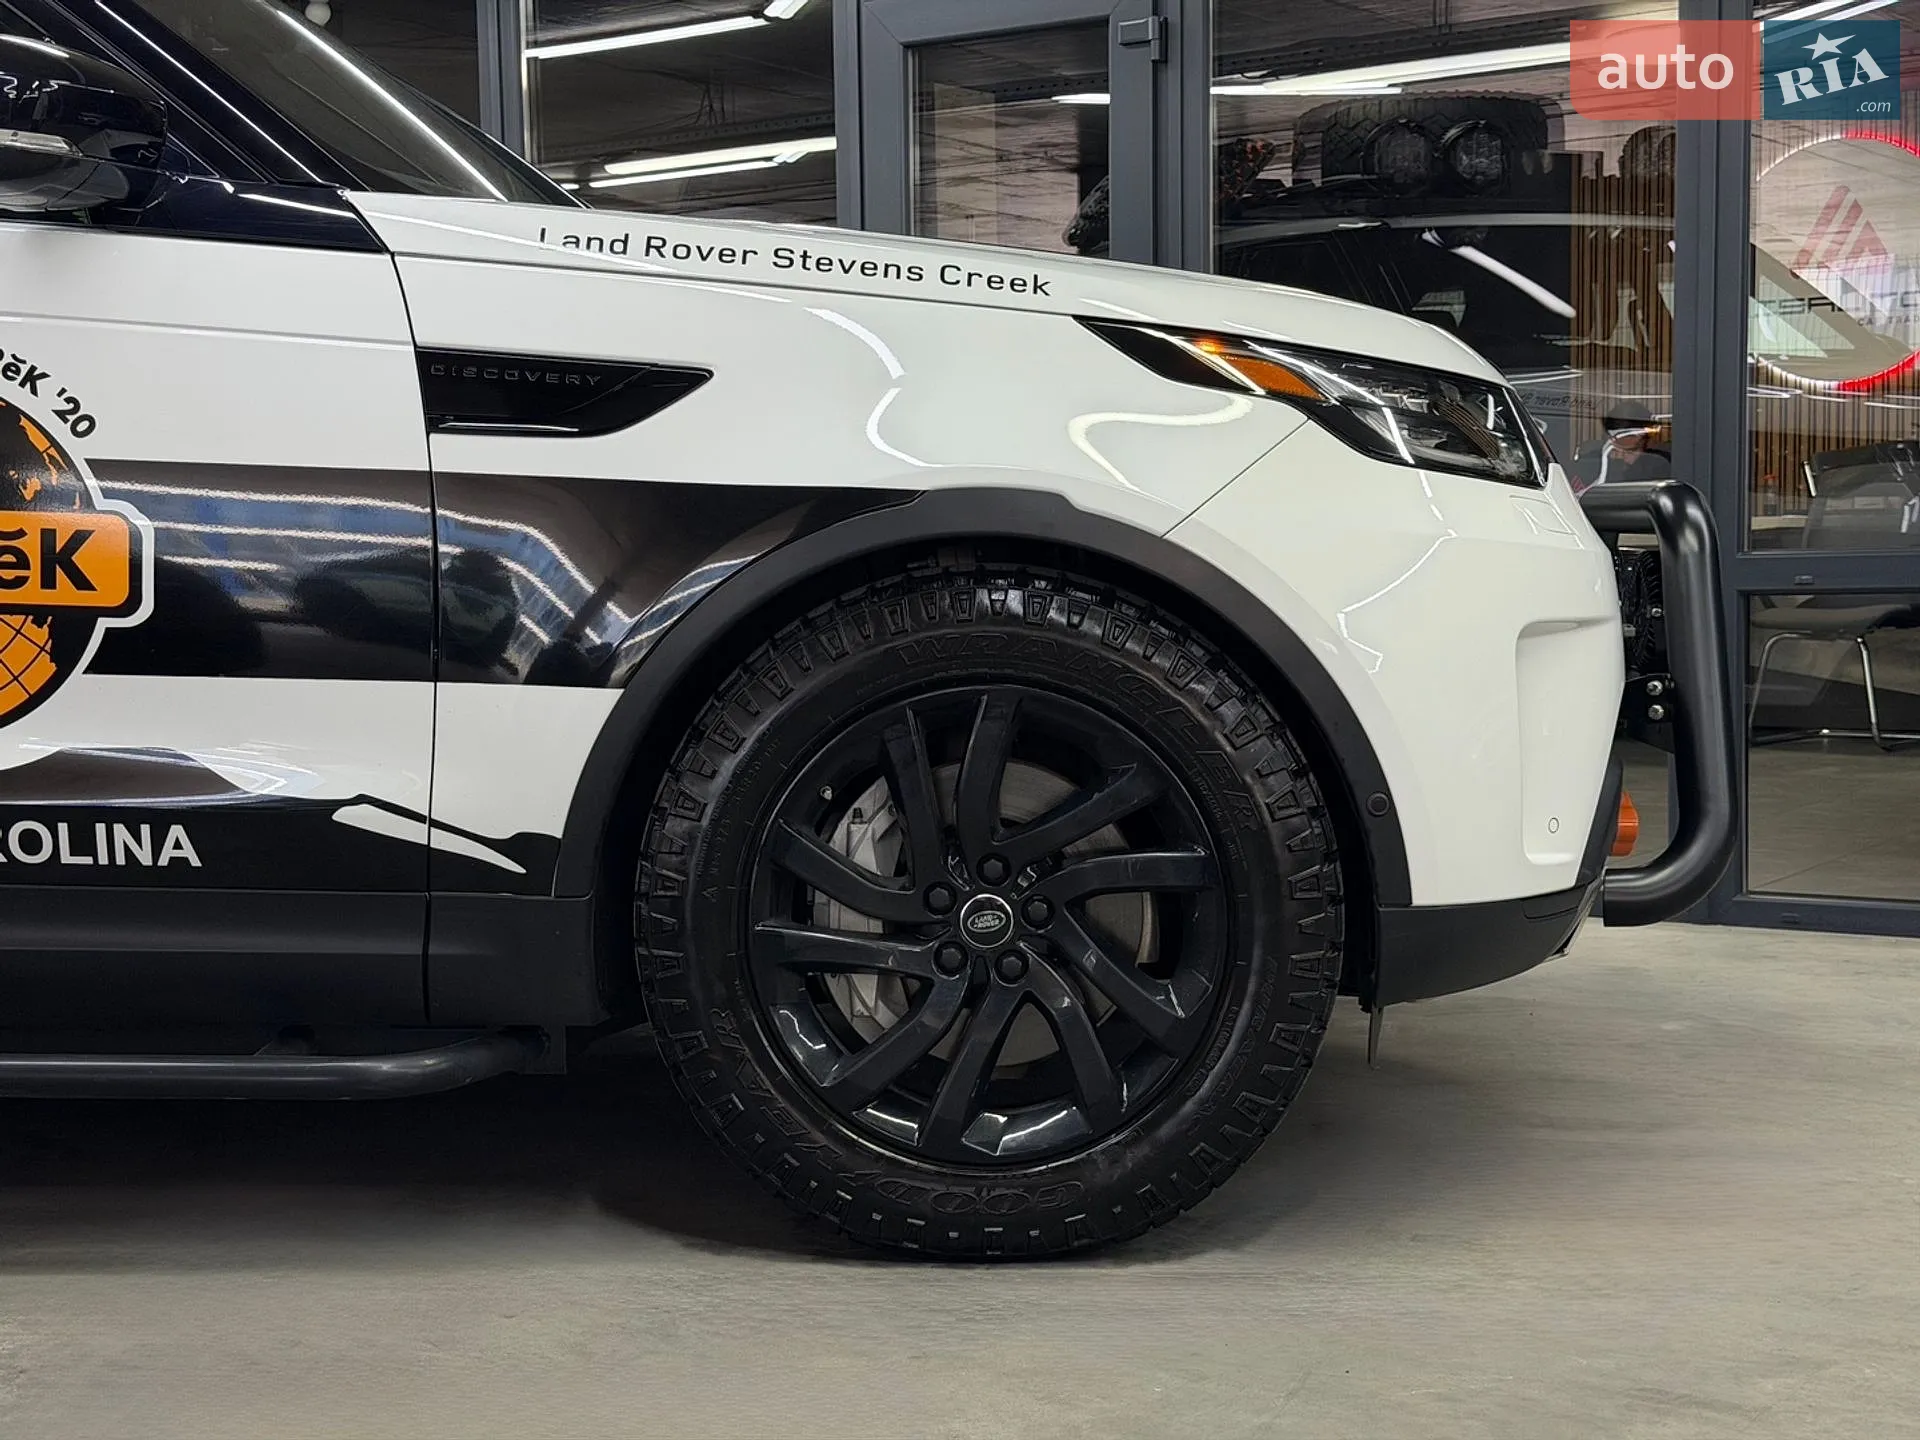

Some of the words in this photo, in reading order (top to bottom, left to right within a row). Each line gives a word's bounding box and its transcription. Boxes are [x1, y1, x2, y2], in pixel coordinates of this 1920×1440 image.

[539, 227, 629, 256] Land
[643, 235, 759, 265] Rover
[771, 247, 925, 282] Stevens
[939, 263, 1052, 297] Creek
[430, 362, 601, 386] DISCOVERY
[51, 386, 97, 439] '20
